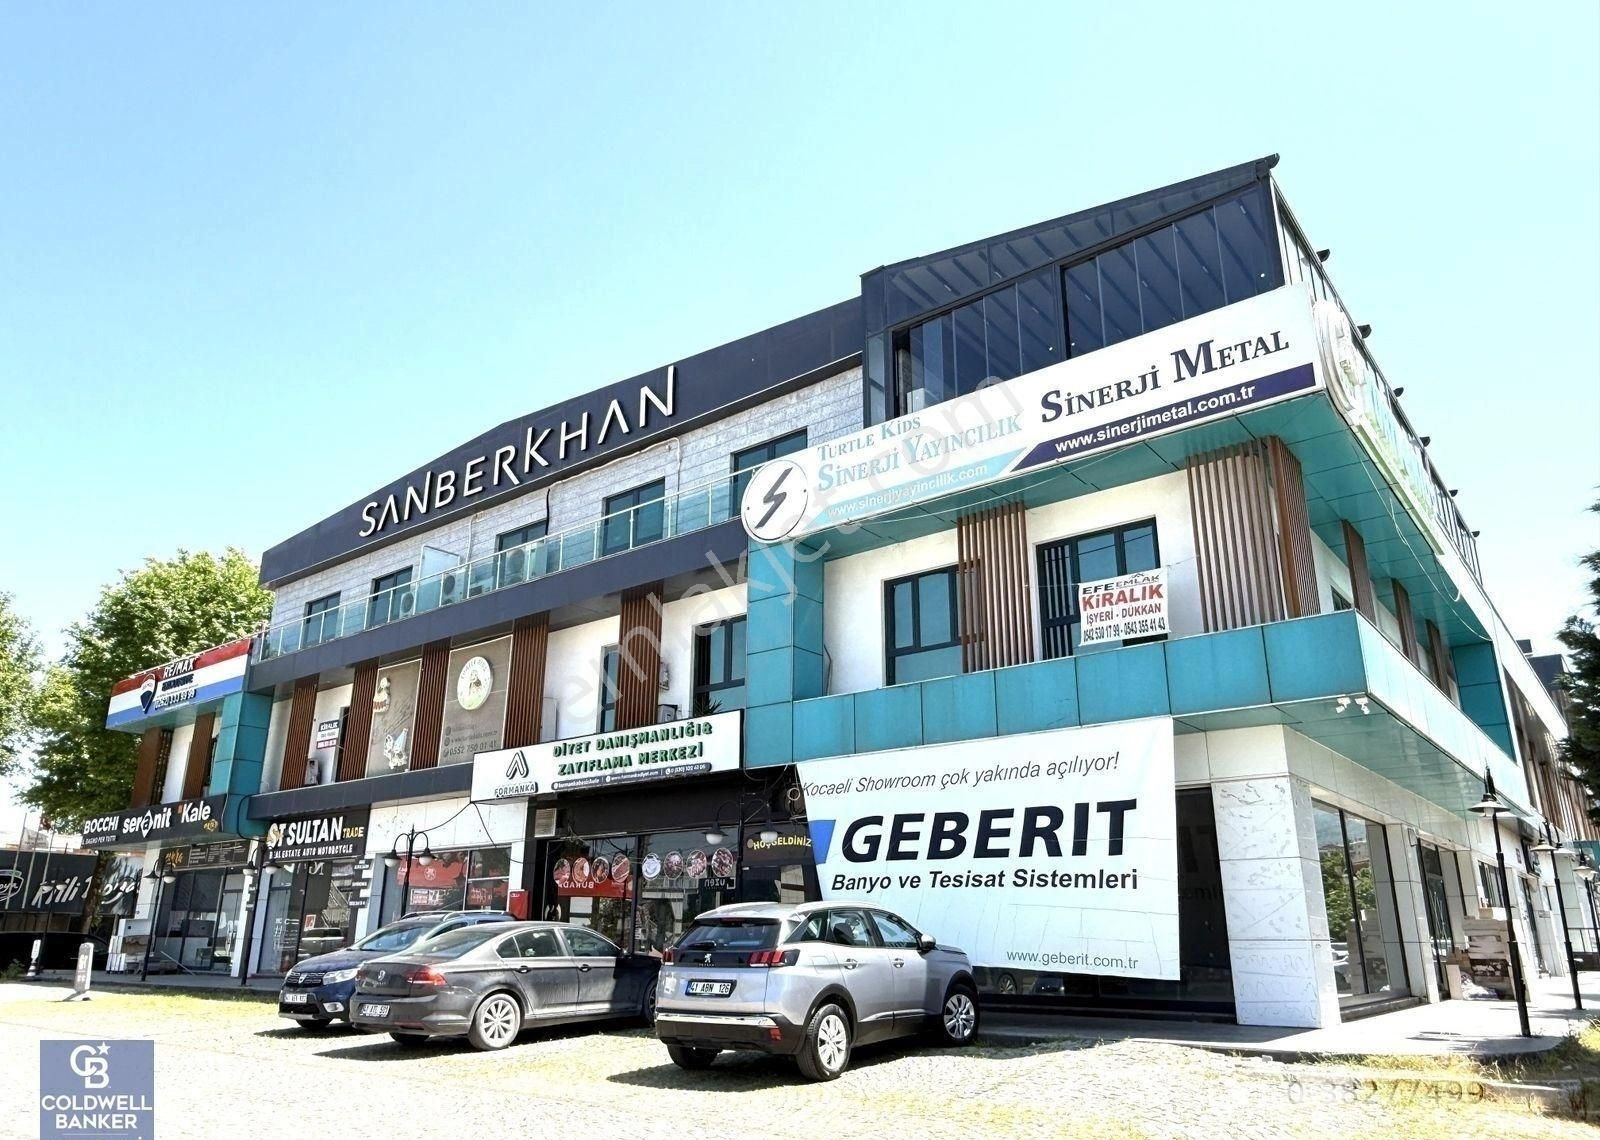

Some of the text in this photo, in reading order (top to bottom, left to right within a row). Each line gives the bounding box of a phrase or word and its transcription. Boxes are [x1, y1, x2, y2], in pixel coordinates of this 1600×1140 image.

[1170, 330, 1289, 383] METAL
[1055, 384, 1256, 453] www.sinerjimetal.com.tr
[358, 365, 676, 537] SANBERKHAN
[817, 433, 874, 461] TURTLE
[901, 413, 1023, 465] YAYINCILIK
[826, 463, 988, 517] www.sinerjiyayincilik.com
[1105, 624, 1112, 639] 17
[1124, 621, 1138, 636] 0543
[553, 741, 591, 758] DİYET
[557, 742, 704, 776] ZAYIFLAMA MERKEZİ
[494, 783, 535, 796] FORMANKA
[803, 751, 1119, 797] Kocaeli Showroom çok yakında açılıyor!
[83, 816, 119, 834] BOCCHI
[180, 801, 211, 824] Kale
[287, 816, 343, 846] SULTAN
[343, 826, 364, 838] TRADE
[841, 798, 1137, 863] GEBERIT
[282, 848, 300, 858] ESTATE
[303, 847, 316, 856] AUTO
[318, 844, 353, 855] MOTORCYCLE
[831, 868, 1138, 894] Banyo ve Tesisat Sistemleri
[1006, 950, 1139, 969] www.geberit.com.tr
